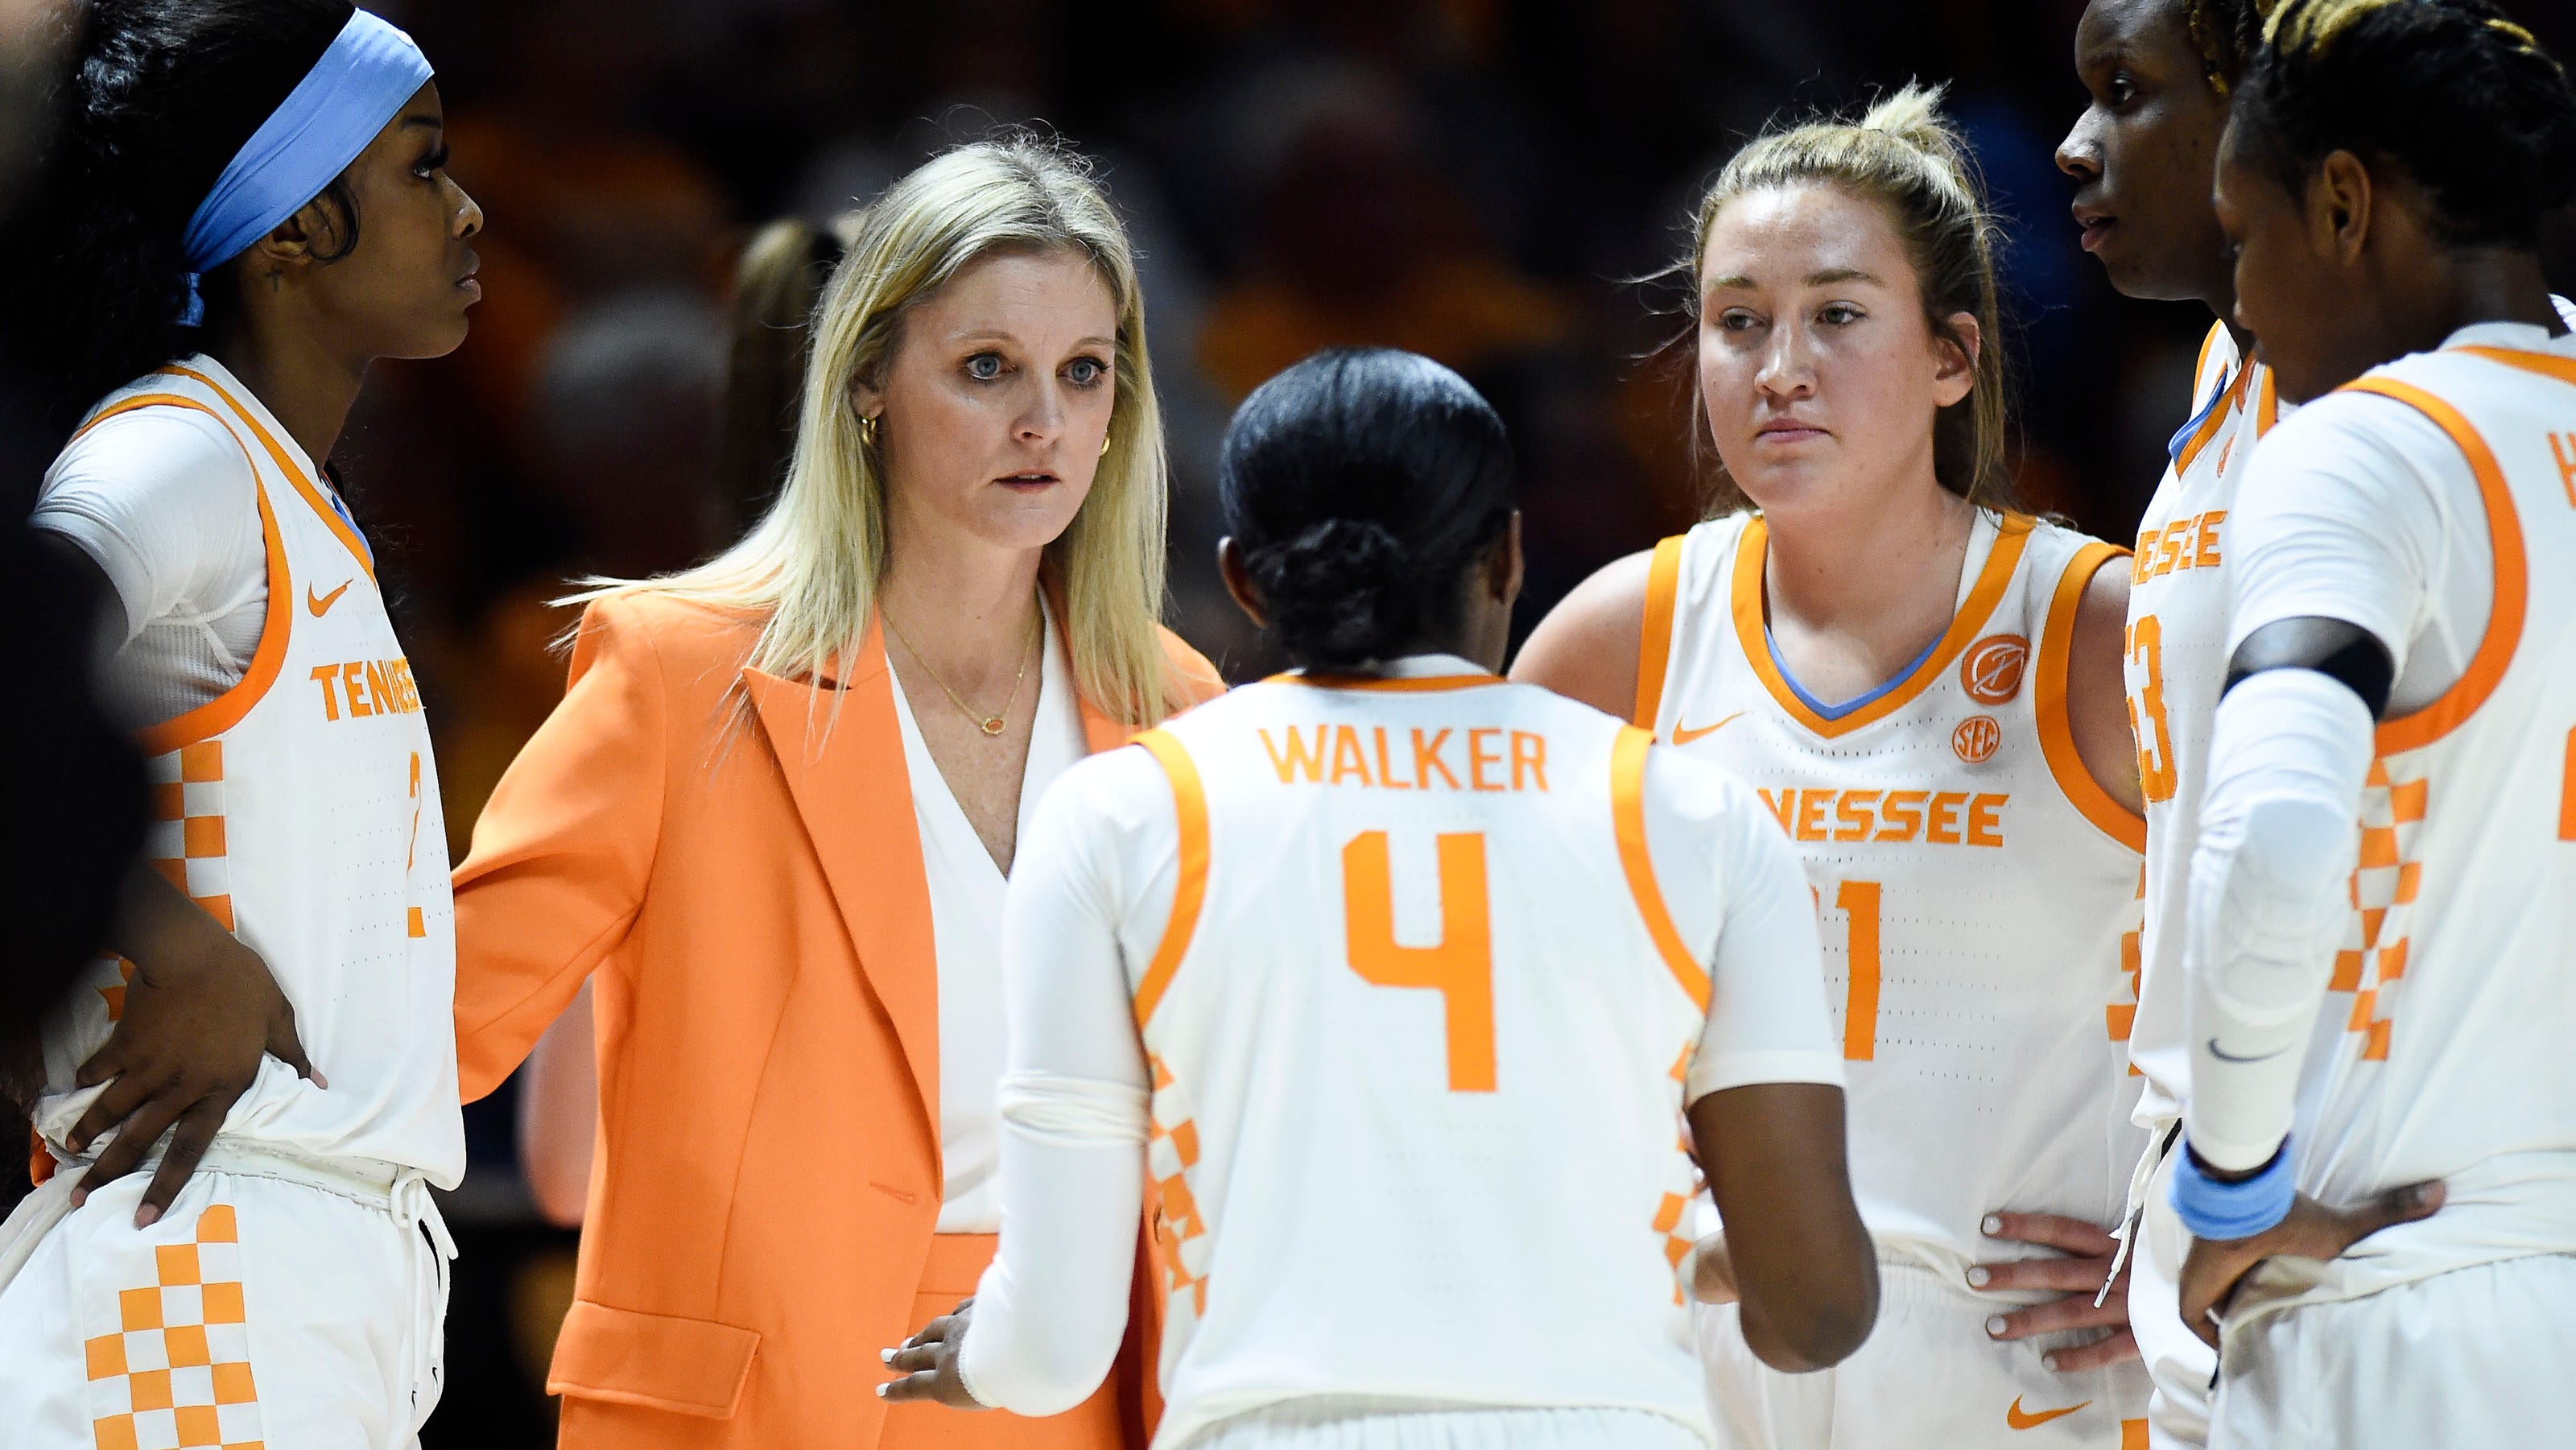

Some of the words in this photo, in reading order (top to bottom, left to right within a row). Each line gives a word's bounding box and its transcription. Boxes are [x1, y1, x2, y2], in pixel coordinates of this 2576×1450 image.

[1257, 725, 1550, 792] WALKER
[1958, 720, 1995, 758] SEC
[1341, 830, 1498, 1093] 4
[1810, 880, 1881, 1062] 1
